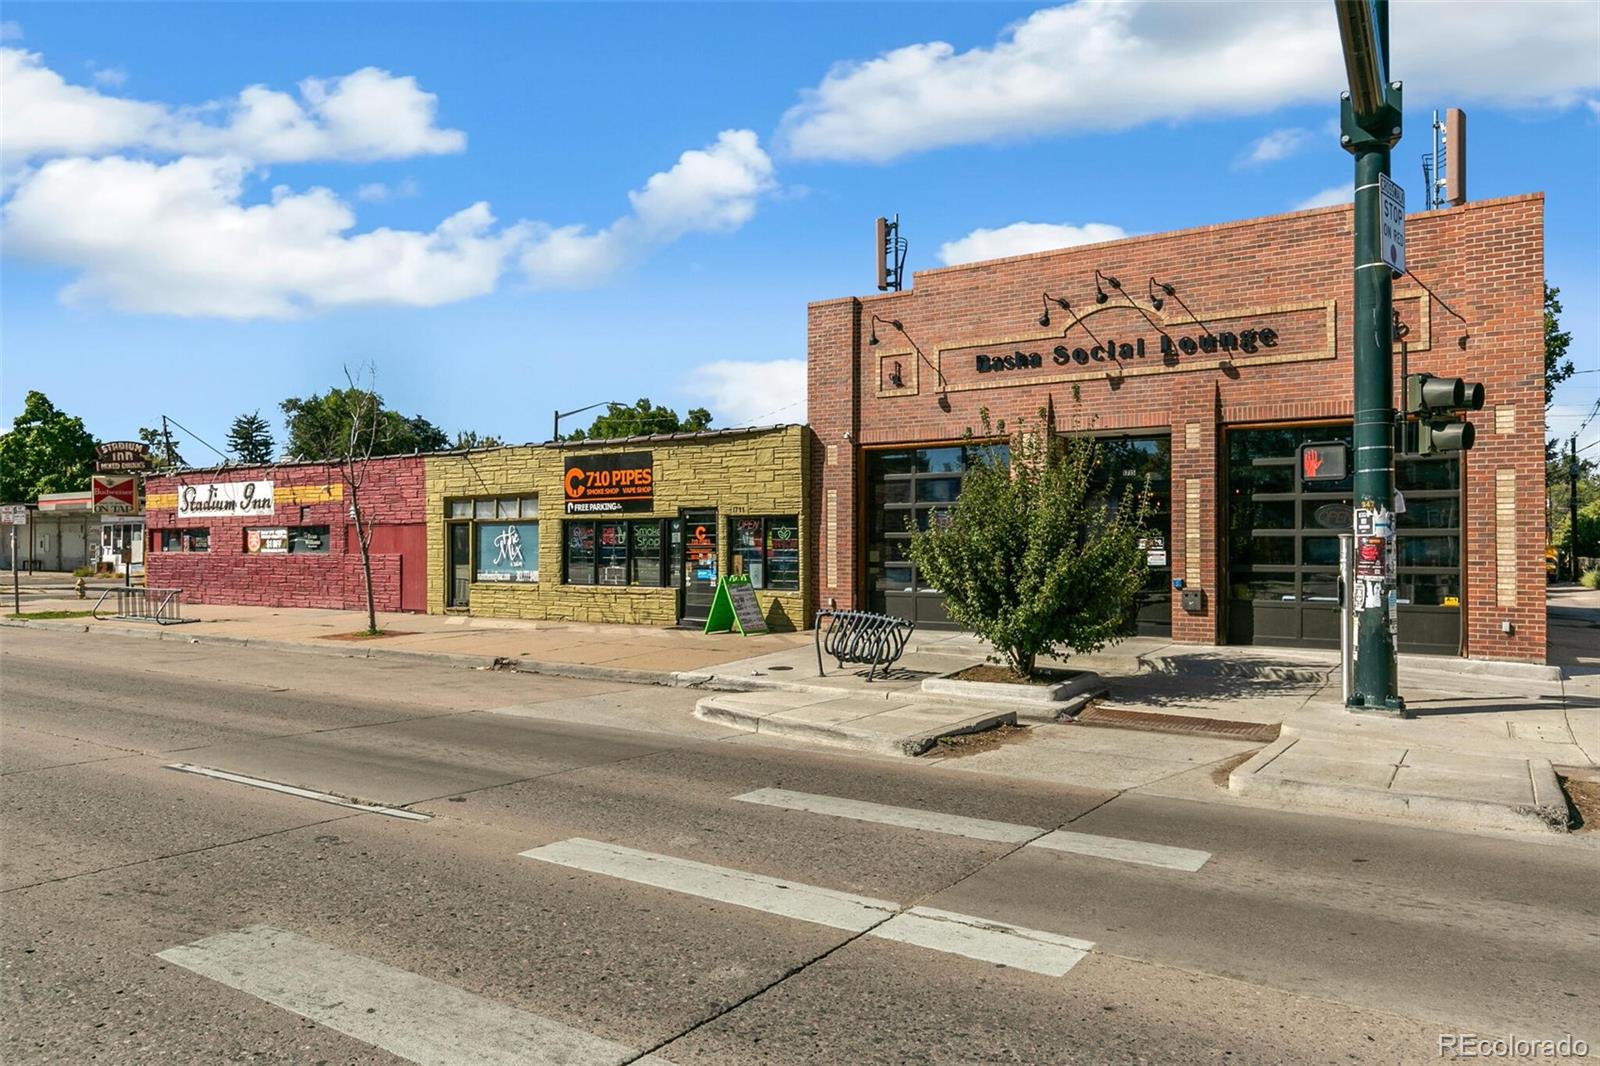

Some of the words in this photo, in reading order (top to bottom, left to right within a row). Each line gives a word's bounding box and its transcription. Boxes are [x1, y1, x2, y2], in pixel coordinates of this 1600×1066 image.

[1384, 199, 1403, 226] STOP
[1383, 222, 1392, 239] ON
[1393, 228, 1404, 247] RED
[1053, 337, 1146, 366] Social
[1160, 326, 1279, 356] Lounge
[101, 442, 143, 454] STADIUM
[586, 471, 610, 487] 710
[612, 468, 652, 486] PIPES
[180, 484, 236, 512] Stadium
[240, 483, 272, 509] Inn
[586, 488, 603, 496] SMOKE
[603, 487, 619, 495] SHOP
[95, 505, 108, 513] ON
[111, 505, 133, 513] TAP
[574, 503, 589, 512] FREE
[589, 502, 617, 512] PARKING
[737, 520, 760, 529] OPEN
[633, 525, 661, 537] Smoke
[636, 536, 661, 548] Shop
[493, 539, 524, 565] Mix
